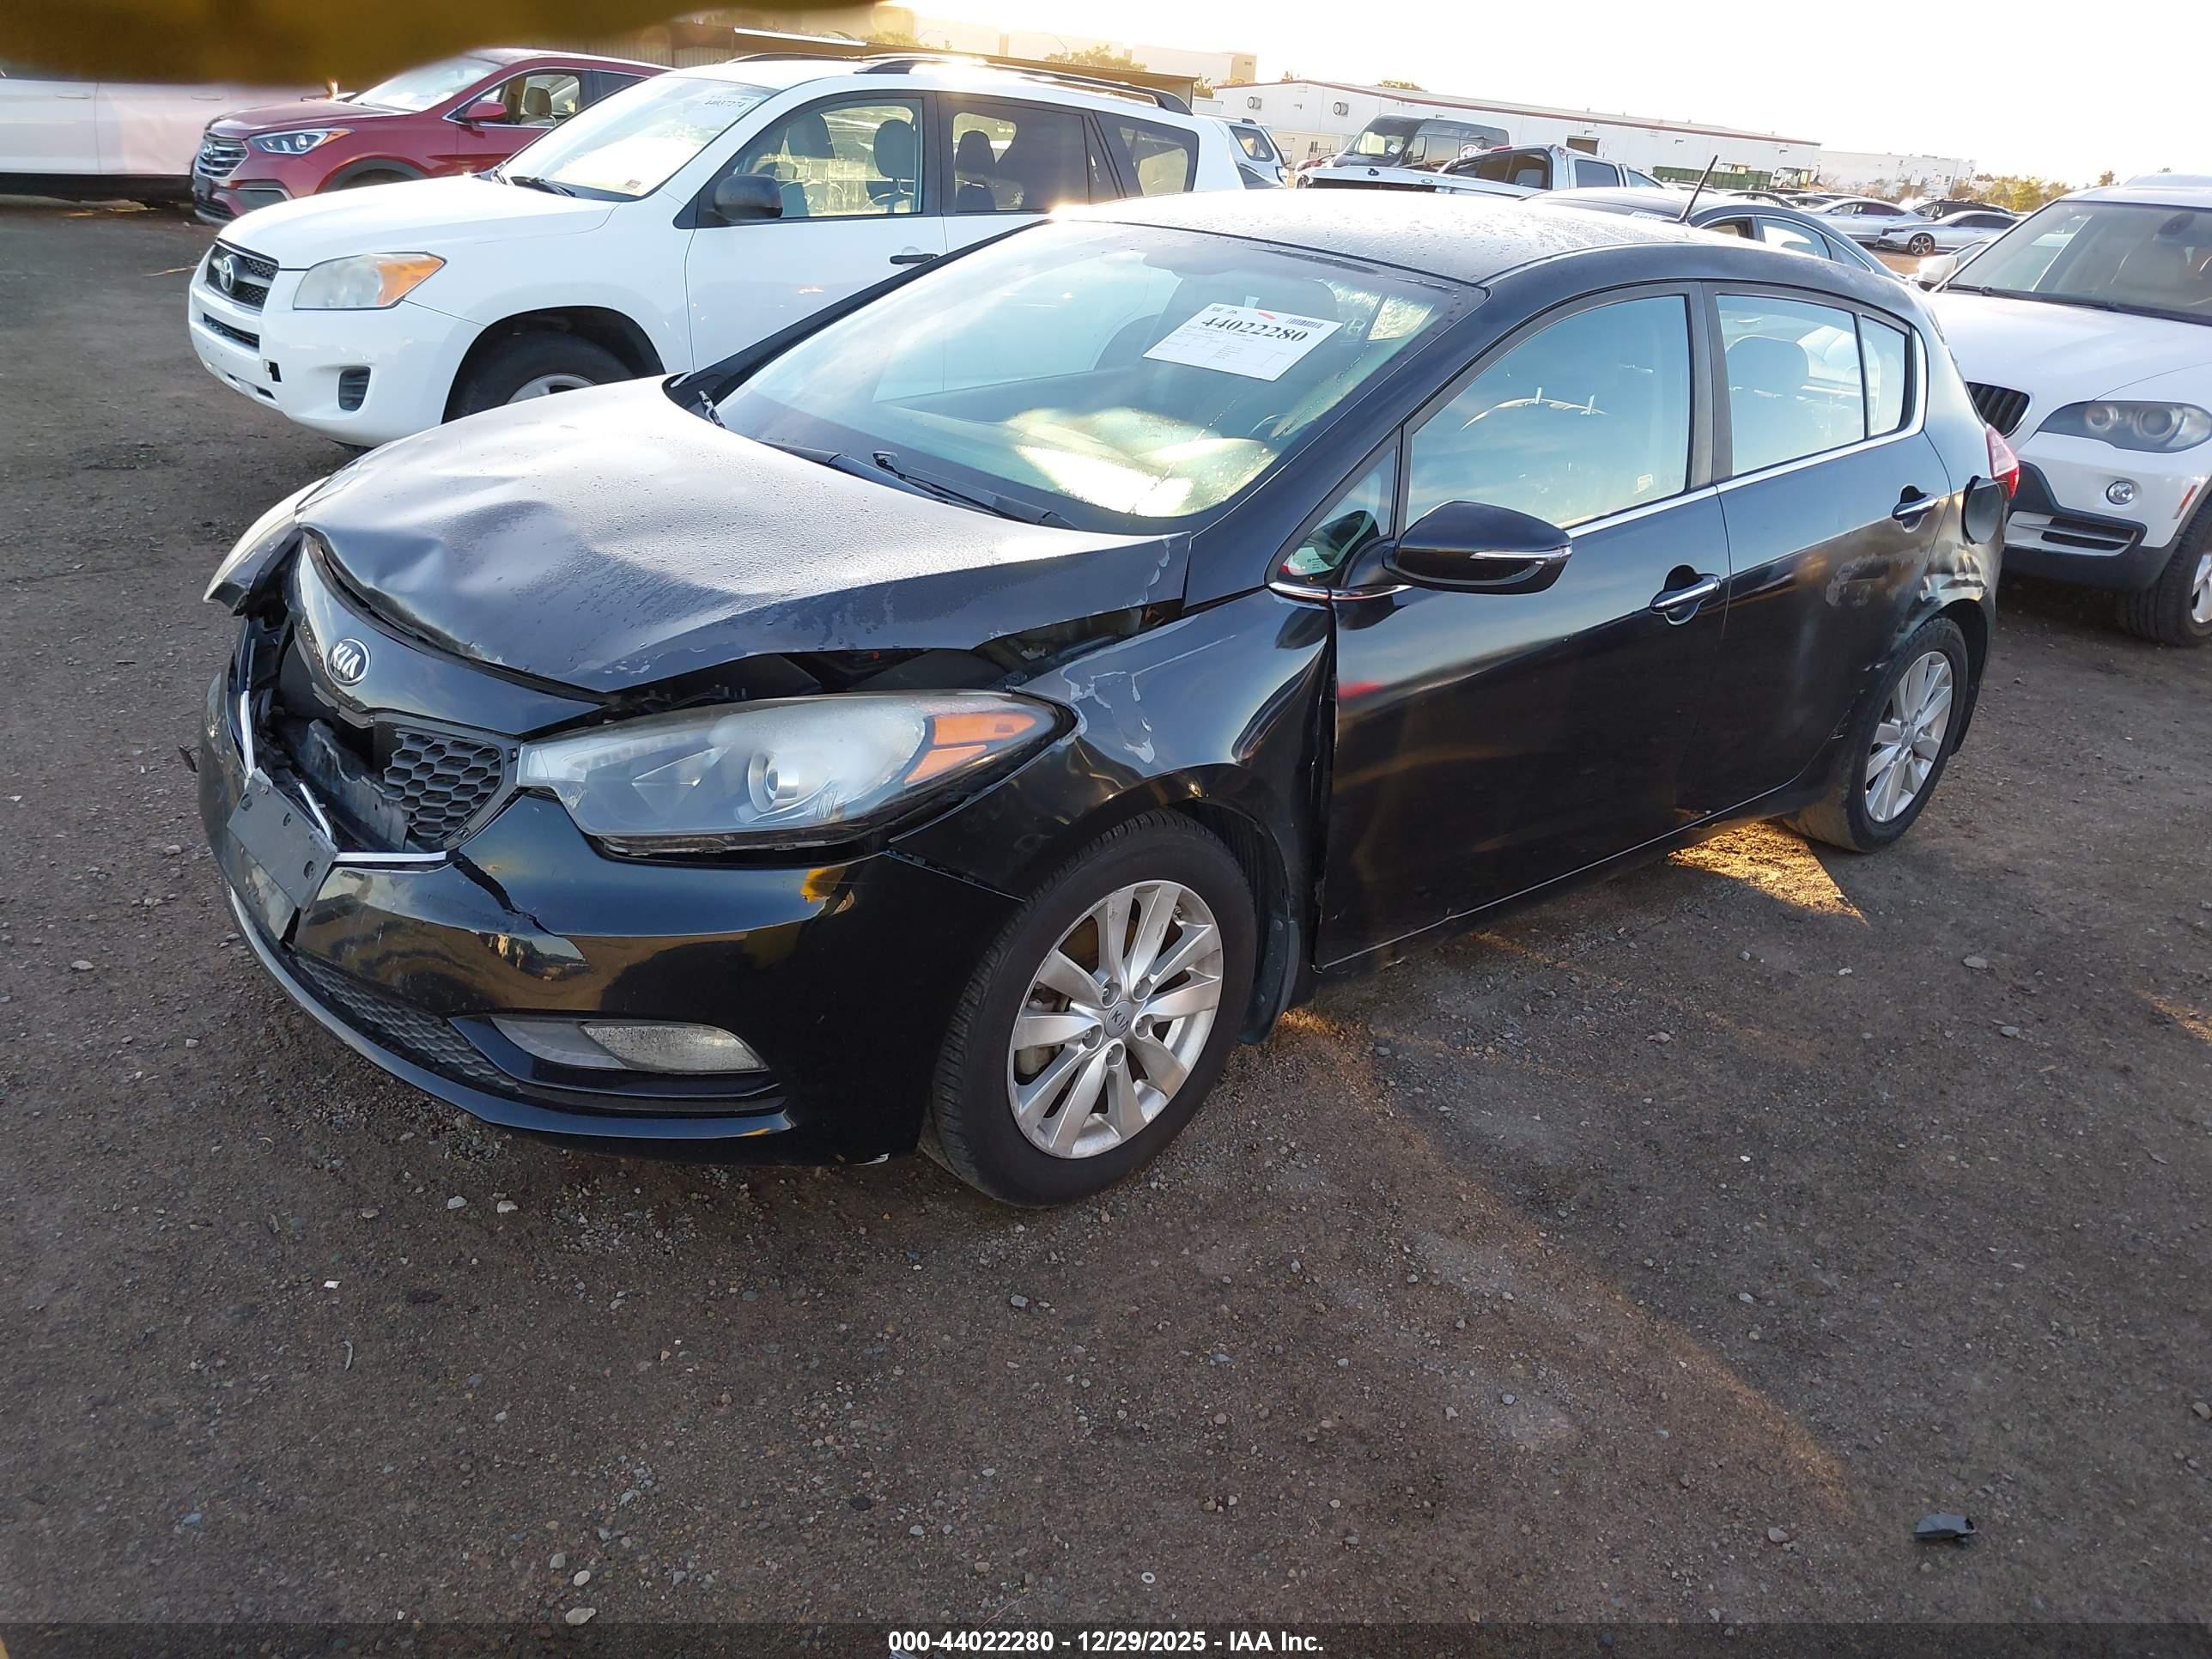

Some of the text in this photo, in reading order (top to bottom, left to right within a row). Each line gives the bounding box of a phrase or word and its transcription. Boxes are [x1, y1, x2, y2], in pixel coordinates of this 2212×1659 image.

[1201, 316, 1309, 342] 44022280
[330, 641, 362, 679] KIA
[1111, 1009, 1129, 1032] KIA
